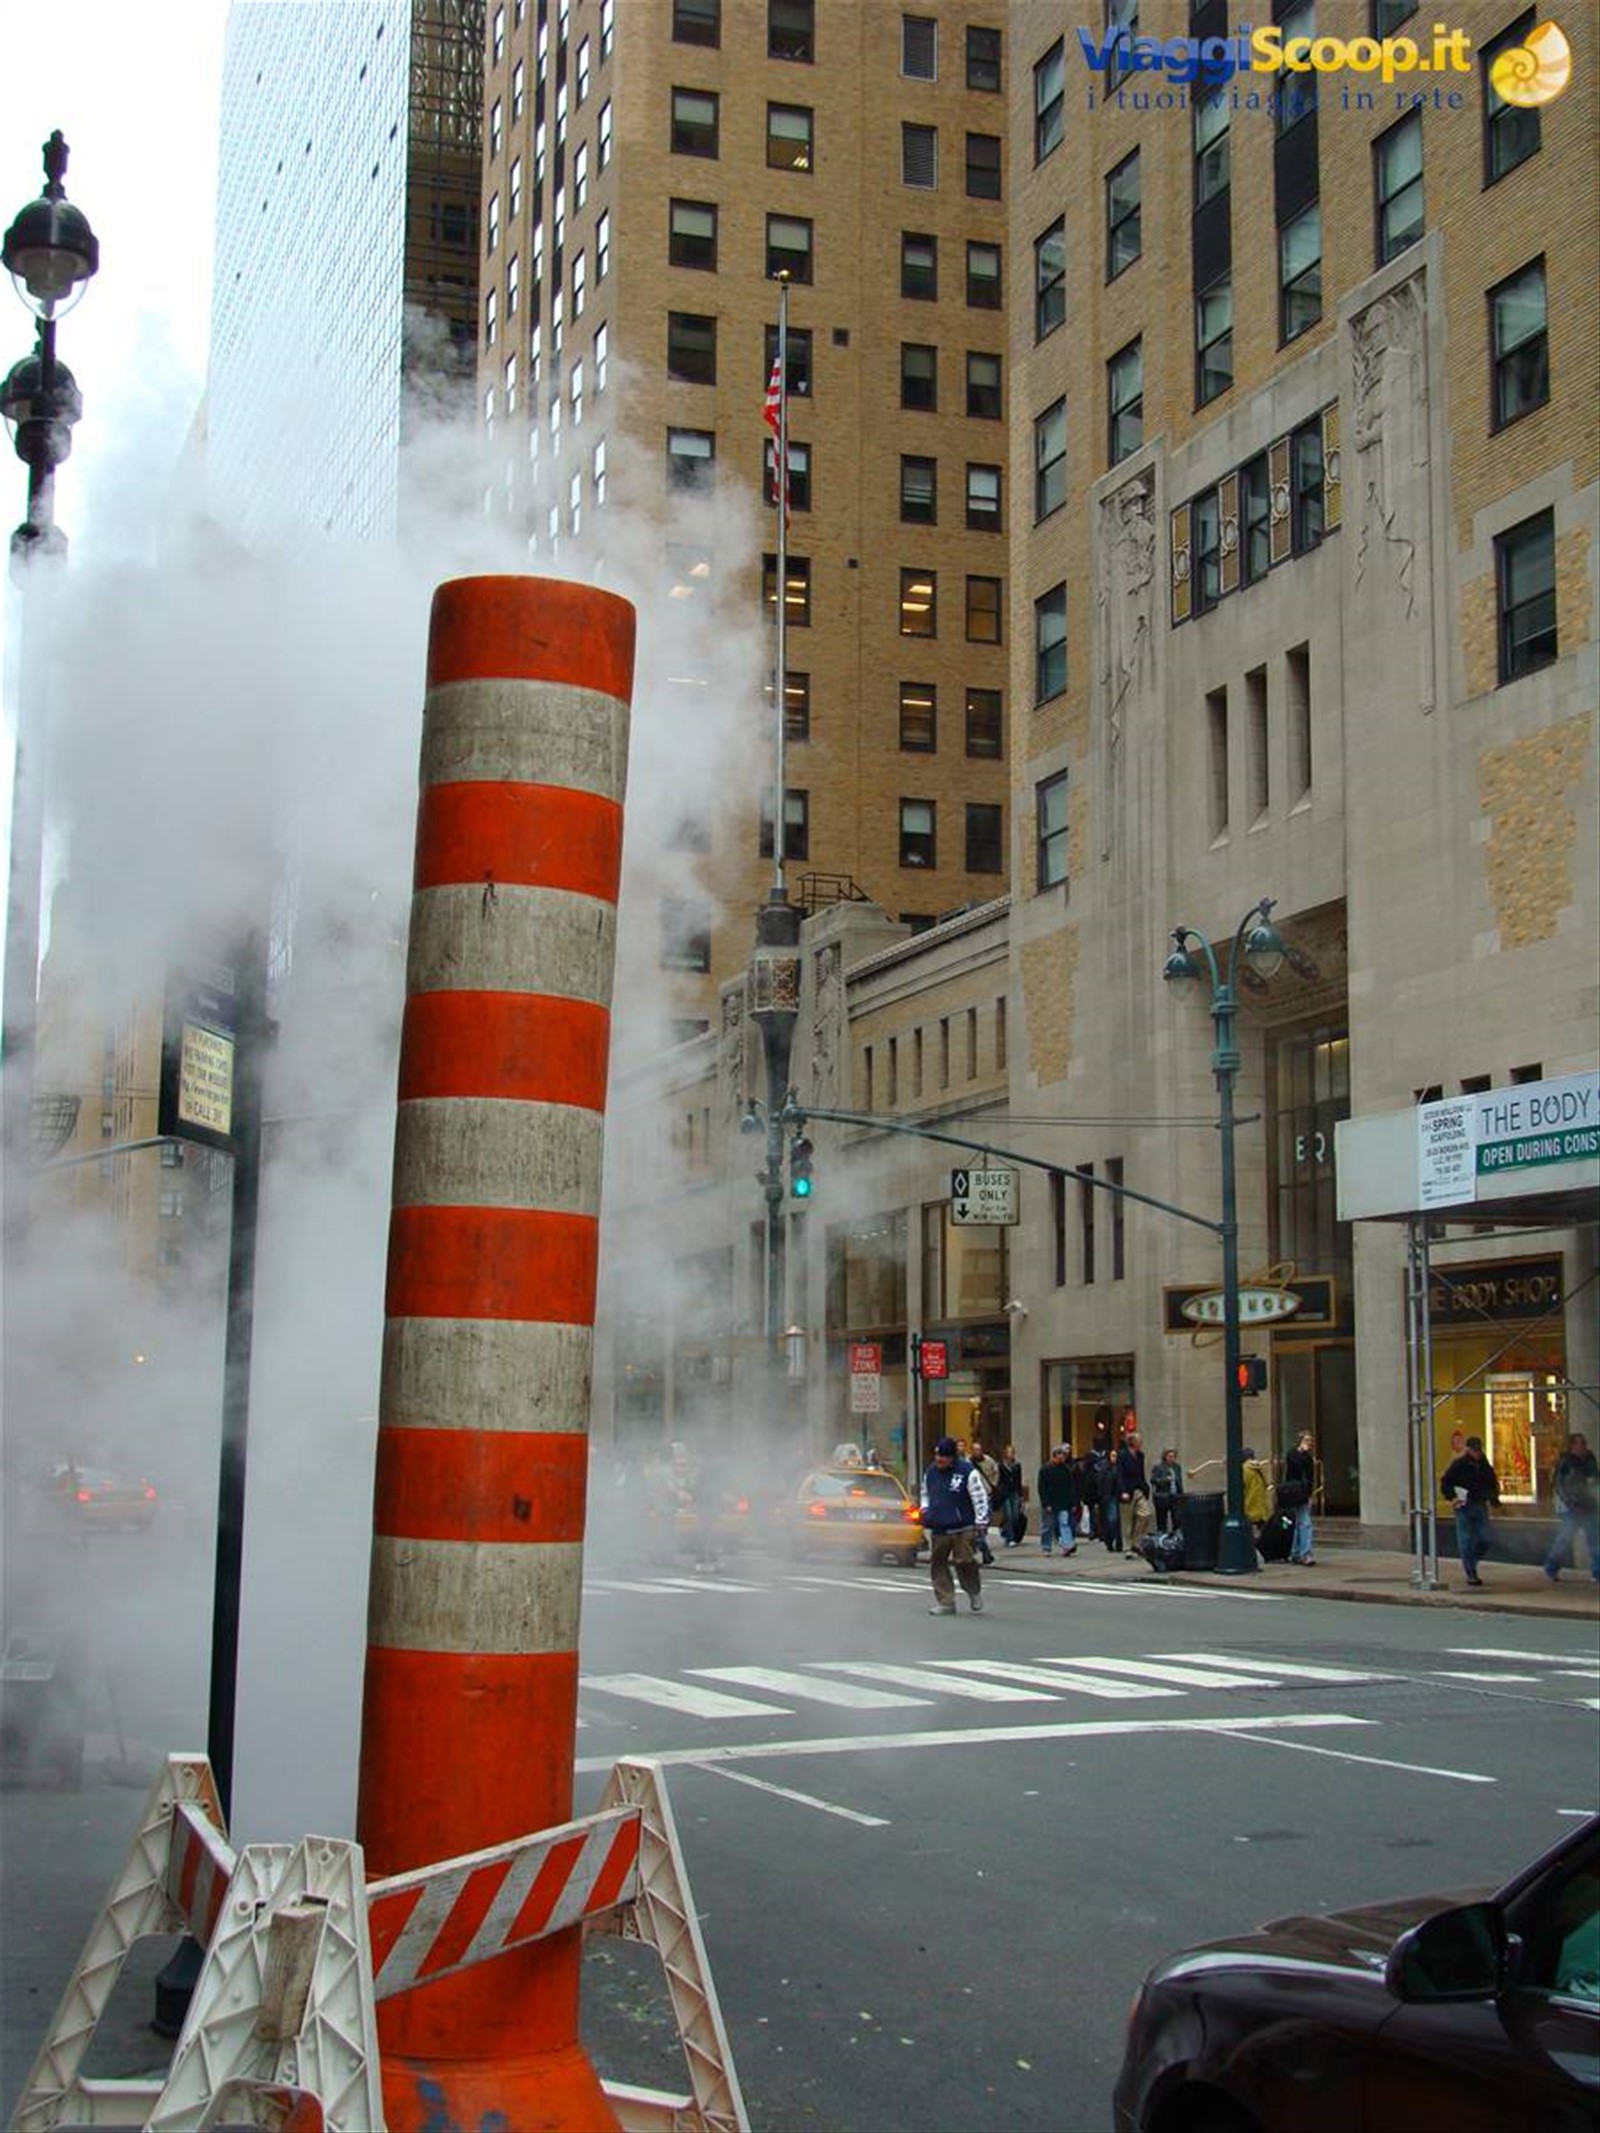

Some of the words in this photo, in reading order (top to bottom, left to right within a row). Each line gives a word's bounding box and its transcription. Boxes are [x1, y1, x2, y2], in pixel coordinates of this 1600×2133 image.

[1482, 1102, 1521, 1135] THE
[1530, 1088, 1591, 1127] BODY
[1433, 1115, 1463, 1133] SPRING
[1483, 1145, 1513, 1167] OPEN
[1517, 1137, 1560, 1161] DURING
[975, 1174, 1010, 1186] BUSES
[979, 1190, 1007, 1201] ONLY
[1452, 1282, 1498, 1309] BODY
[1505, 1276, 1556, 1304] SHOP
[853, 1361, 878, 1372] ZONE
